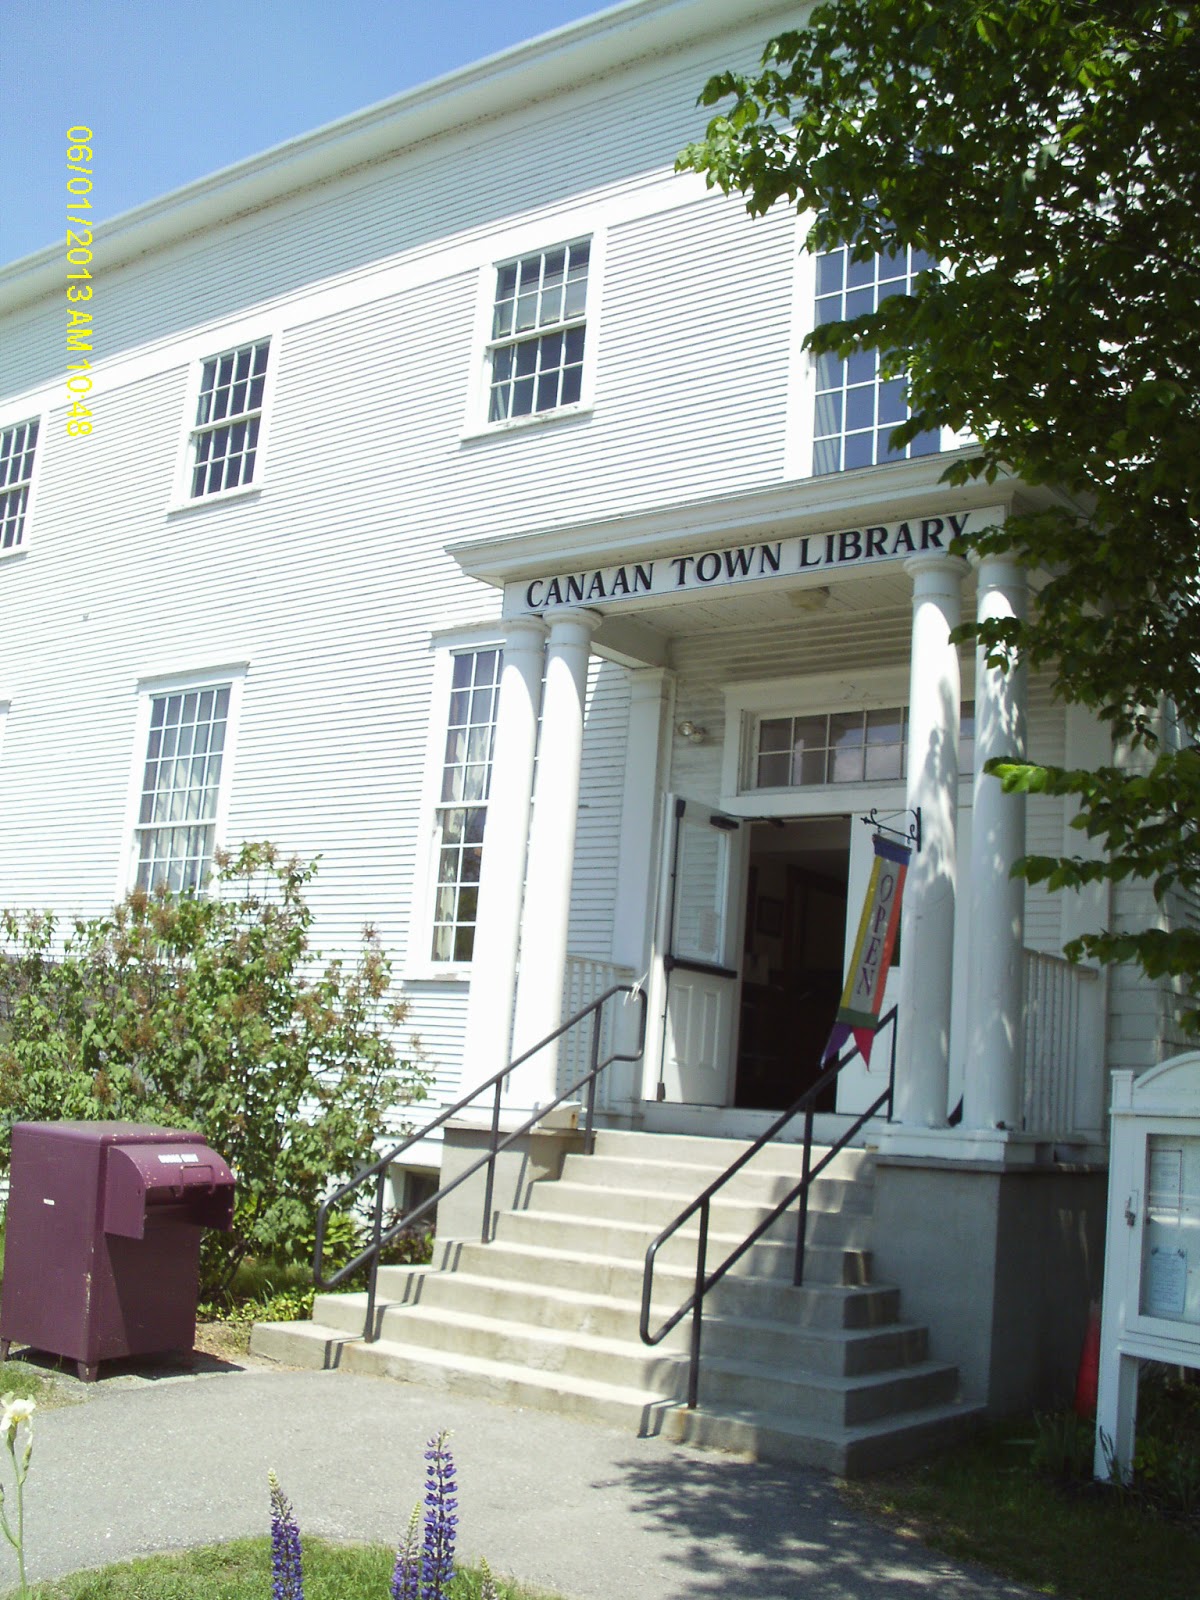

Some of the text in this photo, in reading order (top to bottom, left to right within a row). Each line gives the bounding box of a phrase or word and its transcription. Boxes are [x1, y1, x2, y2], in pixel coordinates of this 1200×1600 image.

[526, 512, 972, 608] CANAAN TOWN LIBRARY
[856, 874, 894, 996] OPEN
